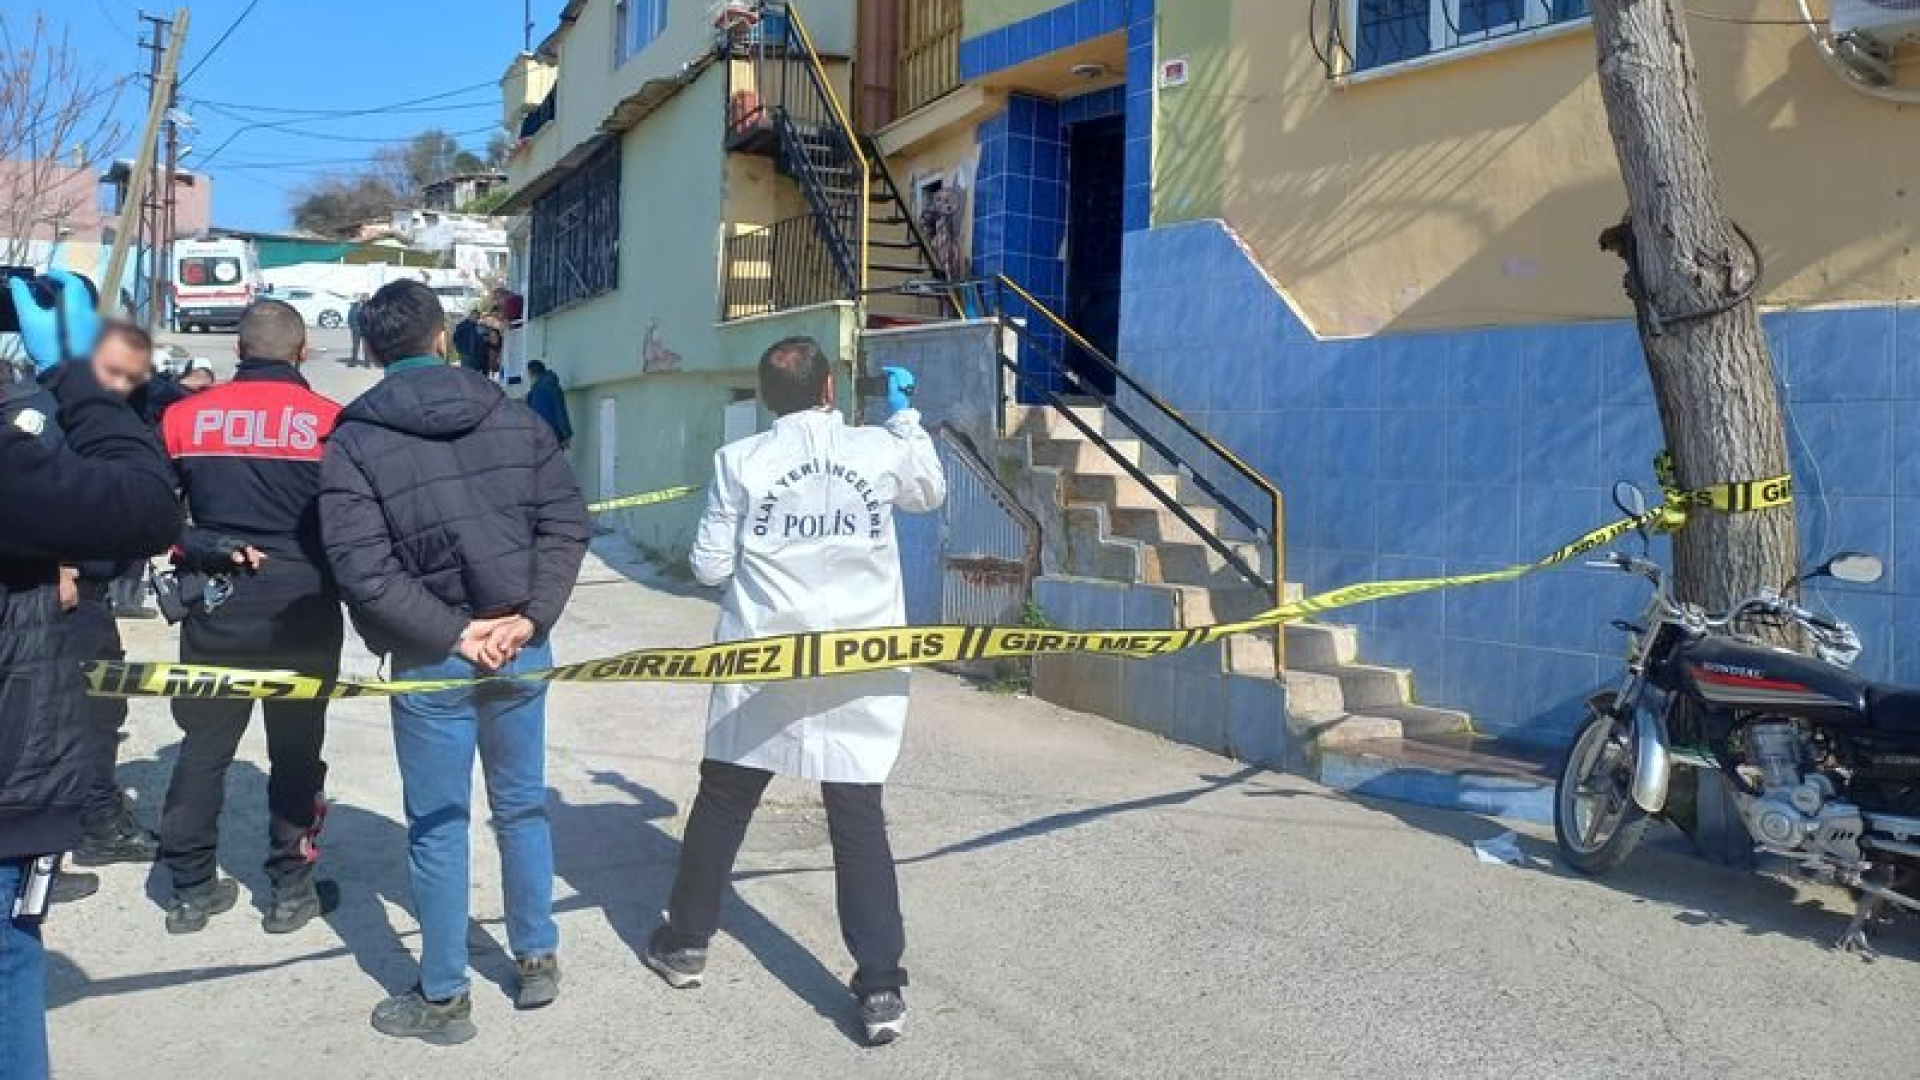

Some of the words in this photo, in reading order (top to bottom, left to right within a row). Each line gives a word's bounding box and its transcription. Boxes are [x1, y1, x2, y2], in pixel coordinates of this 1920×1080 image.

[192, 405, 318, 450] POLİS
[753, 490, 778, 536] OLAY
[774, 457, 820, 488] YERİ
[825, 459, 881, 539] İNCELEME
[784, 508, 856, 537] POLİS
[591, 645, 782, 678] GİRİLMEZ
[834, 633, 945, 667] POLİS
